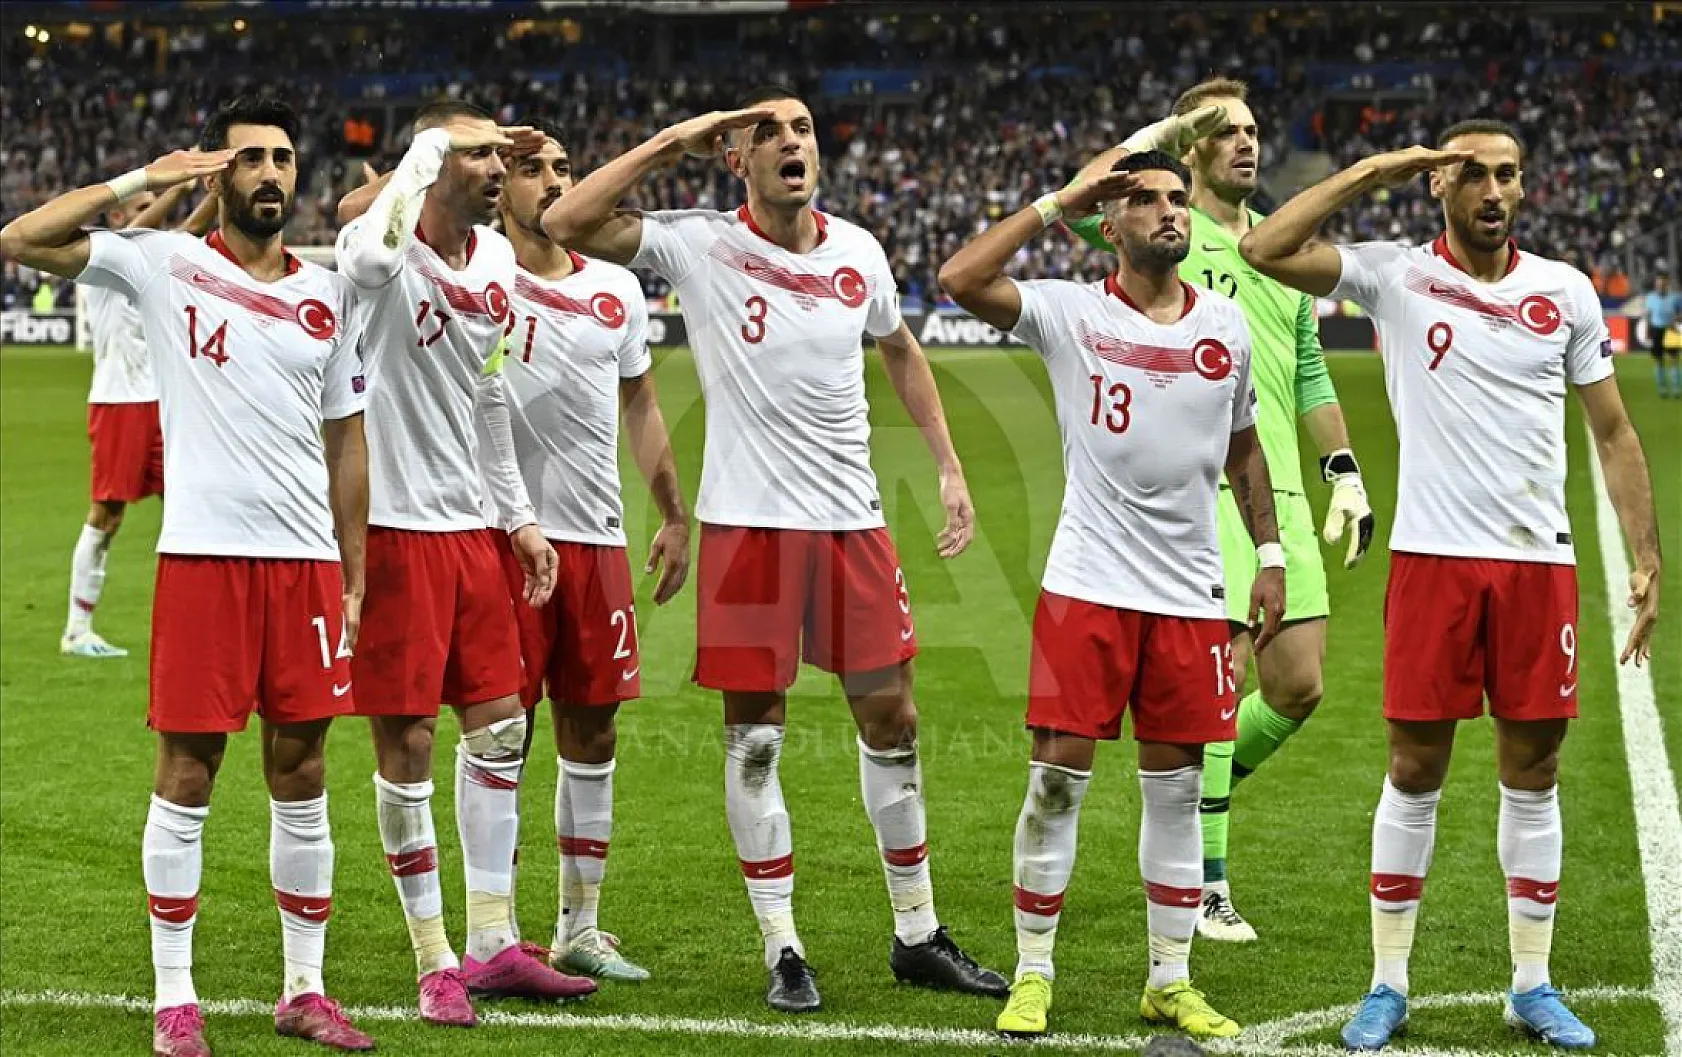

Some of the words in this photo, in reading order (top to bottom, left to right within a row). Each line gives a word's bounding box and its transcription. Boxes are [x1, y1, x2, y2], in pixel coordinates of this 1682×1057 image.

[184, 304, 231, 368] 14
[741, 295, 768, 345] 3
[1427, 321, 1453, 371] 9
[1089, 374, 1132, 434] 13
[895, 566, 911, 614] 3
[1559, 623, 1576, 678] 9
